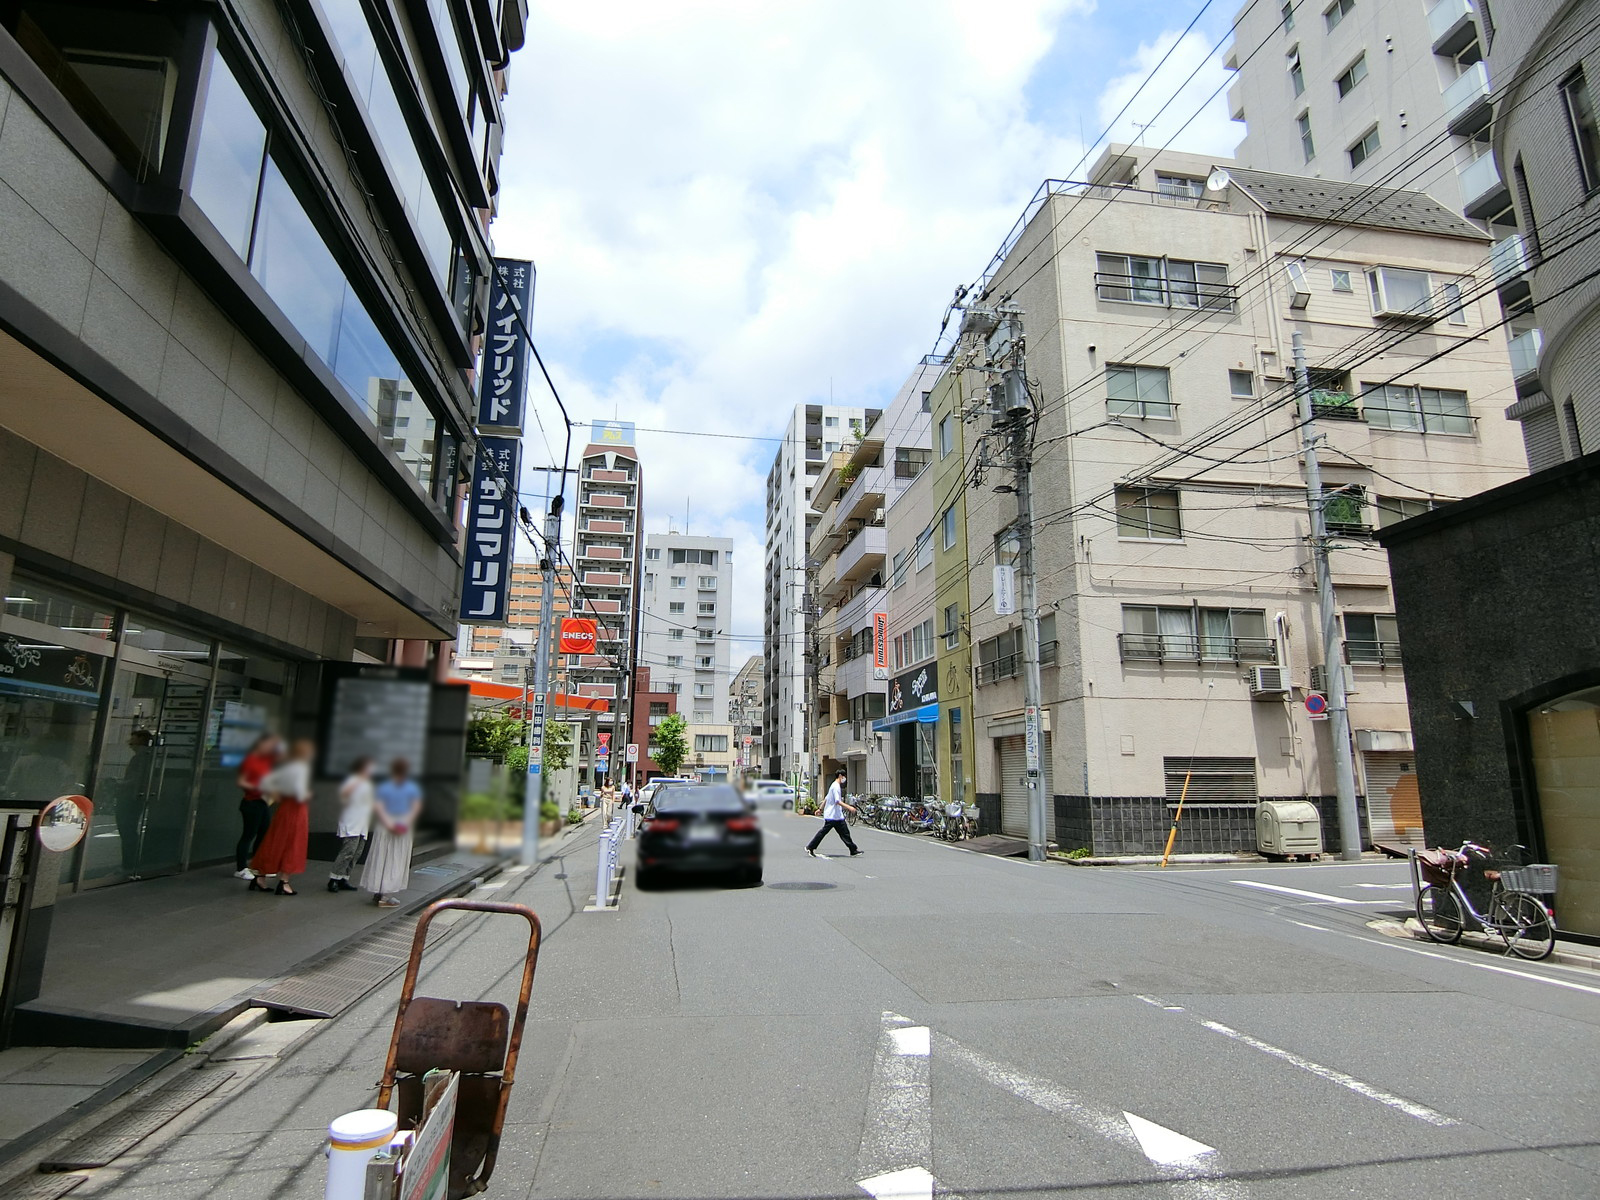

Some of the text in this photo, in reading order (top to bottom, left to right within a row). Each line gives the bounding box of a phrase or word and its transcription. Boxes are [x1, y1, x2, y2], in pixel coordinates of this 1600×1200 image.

[490, 292, 522, 422] ハイブリッド
[468, 476, 507, 616] サンマリノ
[562, 631, 594, 640] ENEOS
